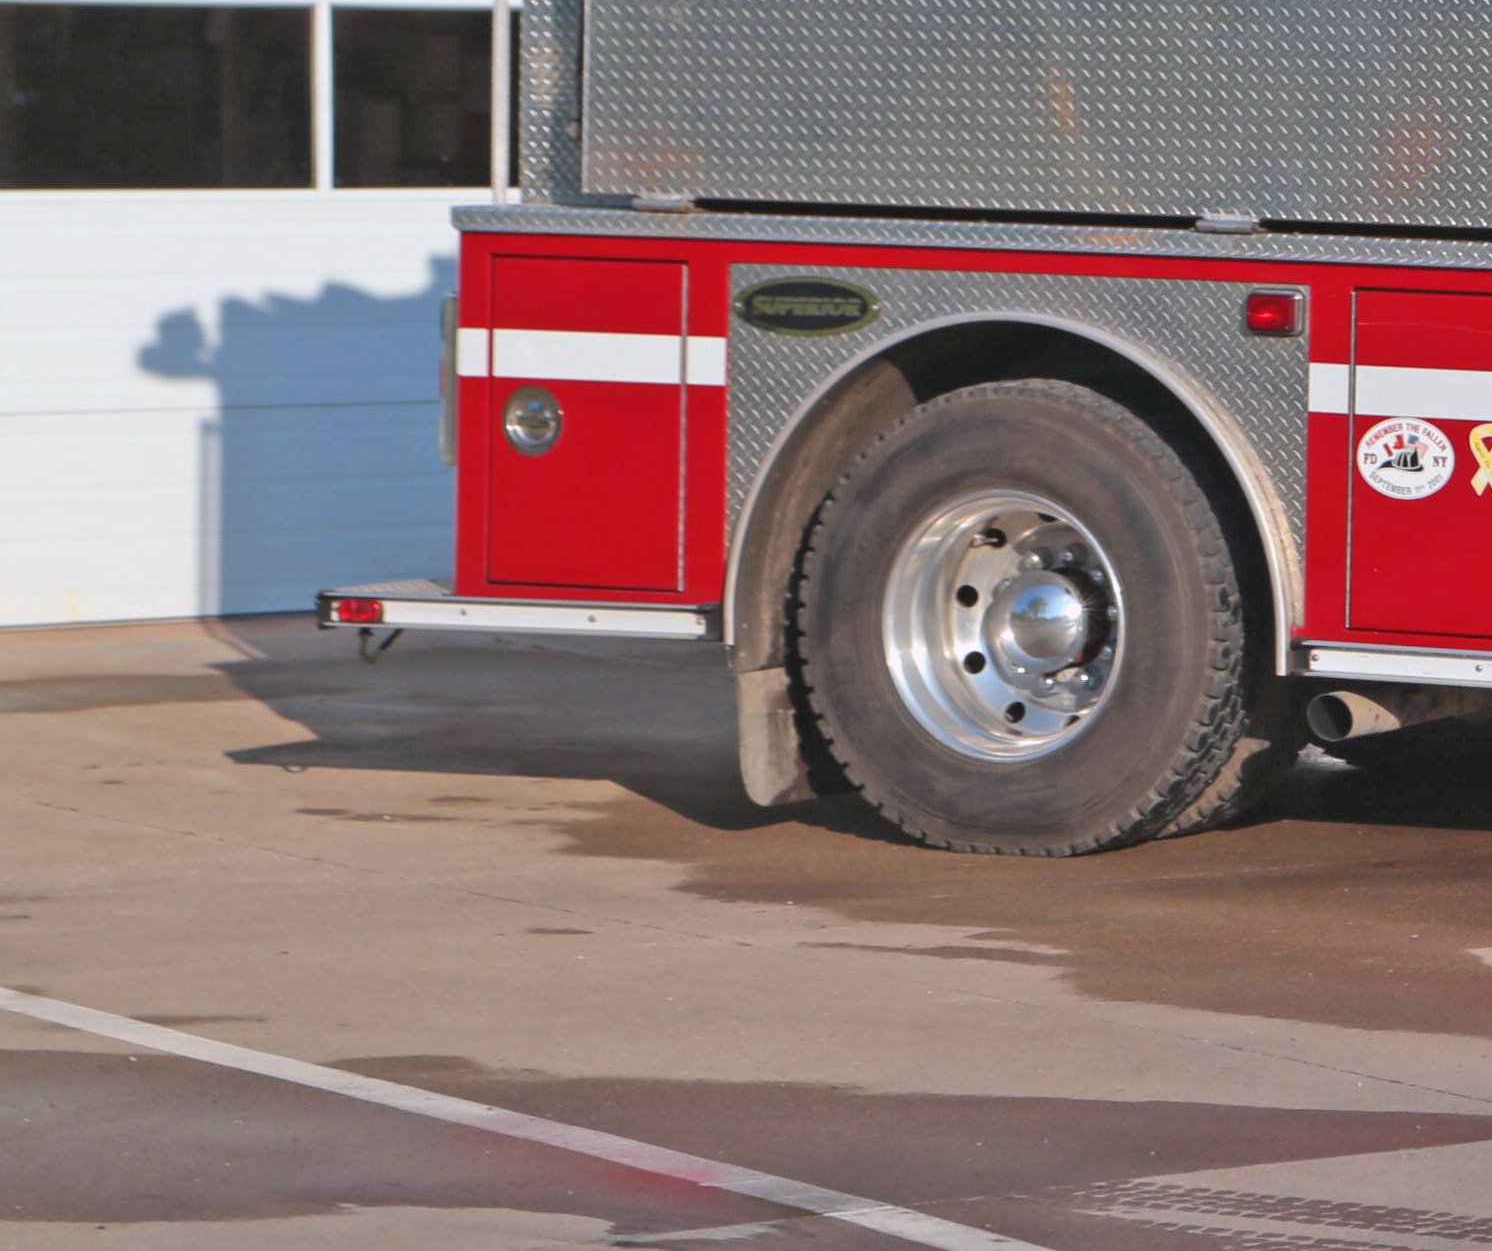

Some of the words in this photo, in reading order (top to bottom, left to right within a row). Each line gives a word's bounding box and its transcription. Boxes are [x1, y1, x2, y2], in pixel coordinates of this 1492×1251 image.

[1406, 423, 1421, 434] THE
[1422, 428, 1447, 451] FALLEN
[1363, 453, 1377, 464] FD
[1432, 456, 1447, 467] NY
[1369, 471, 1412, 495] SEPTEMBER
